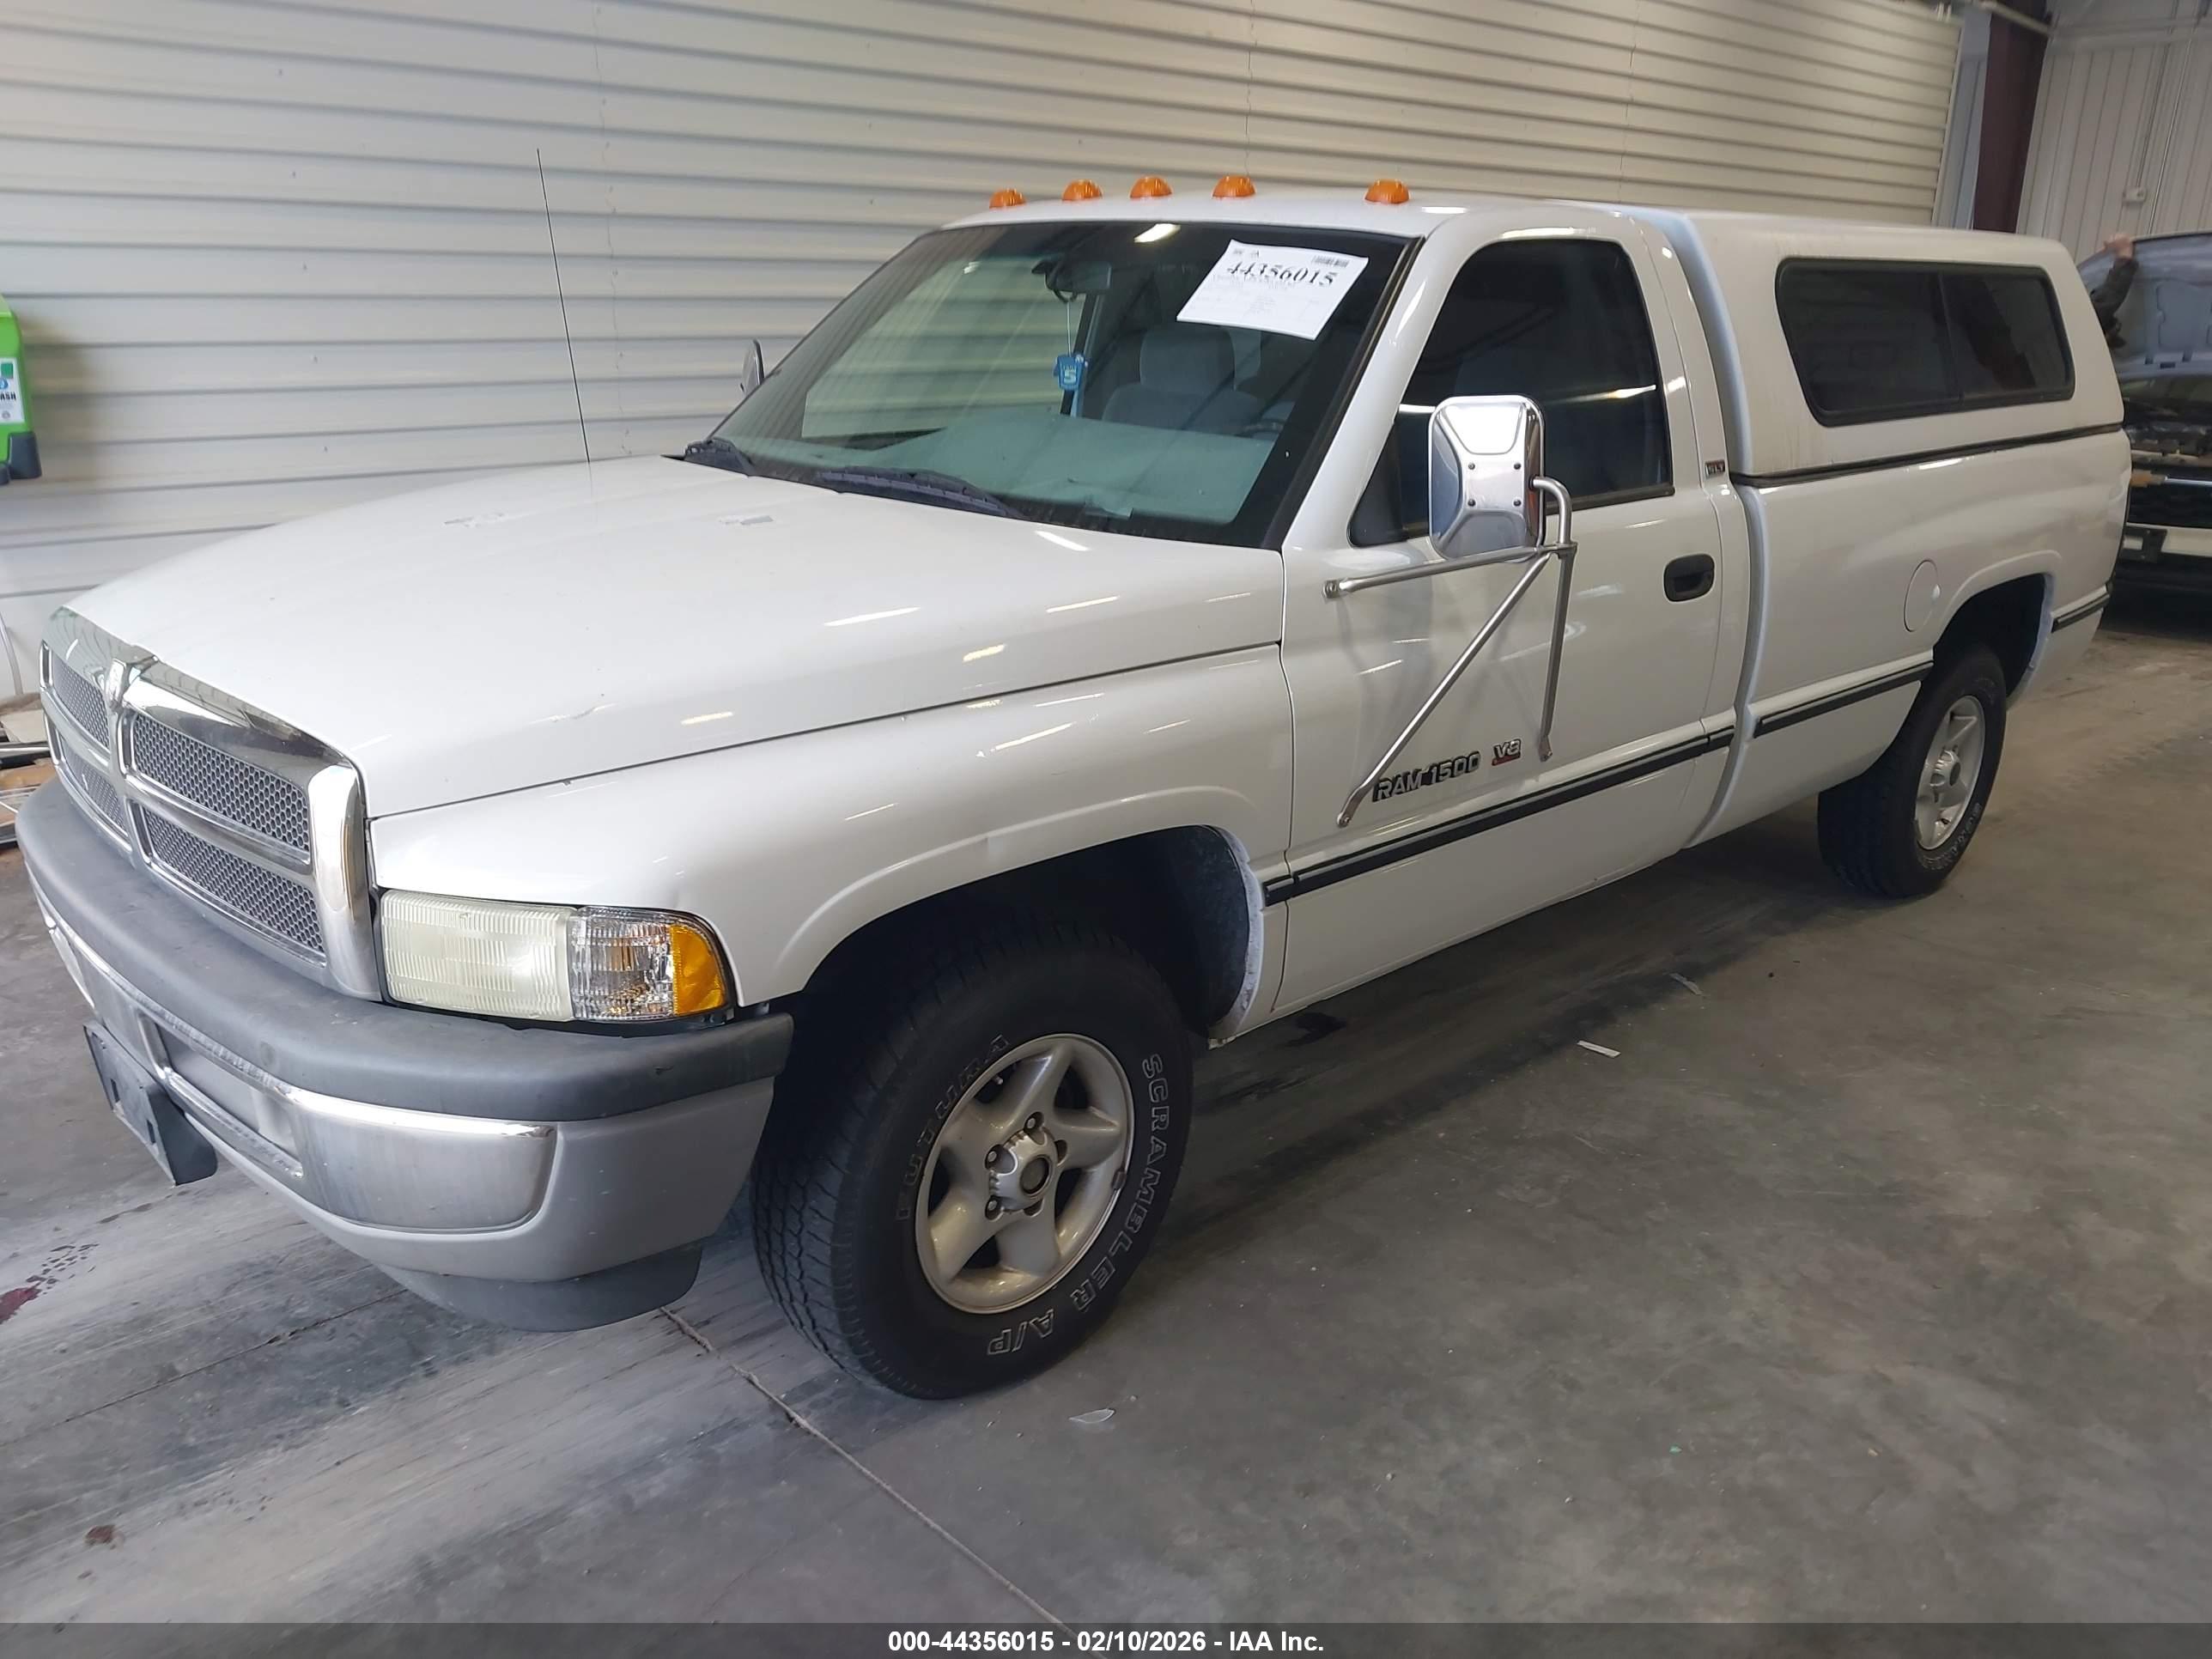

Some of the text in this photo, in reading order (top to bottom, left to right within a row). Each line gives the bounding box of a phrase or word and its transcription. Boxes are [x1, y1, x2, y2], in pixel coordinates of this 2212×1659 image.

[1228, 261, 1338, 286] 44356015
[1493, 738, 1522, 759] V8
[1373, 751, 1481, 802] RAM 1500
[987, 1053, 1170, 1356] SCRAMBLER A/P
